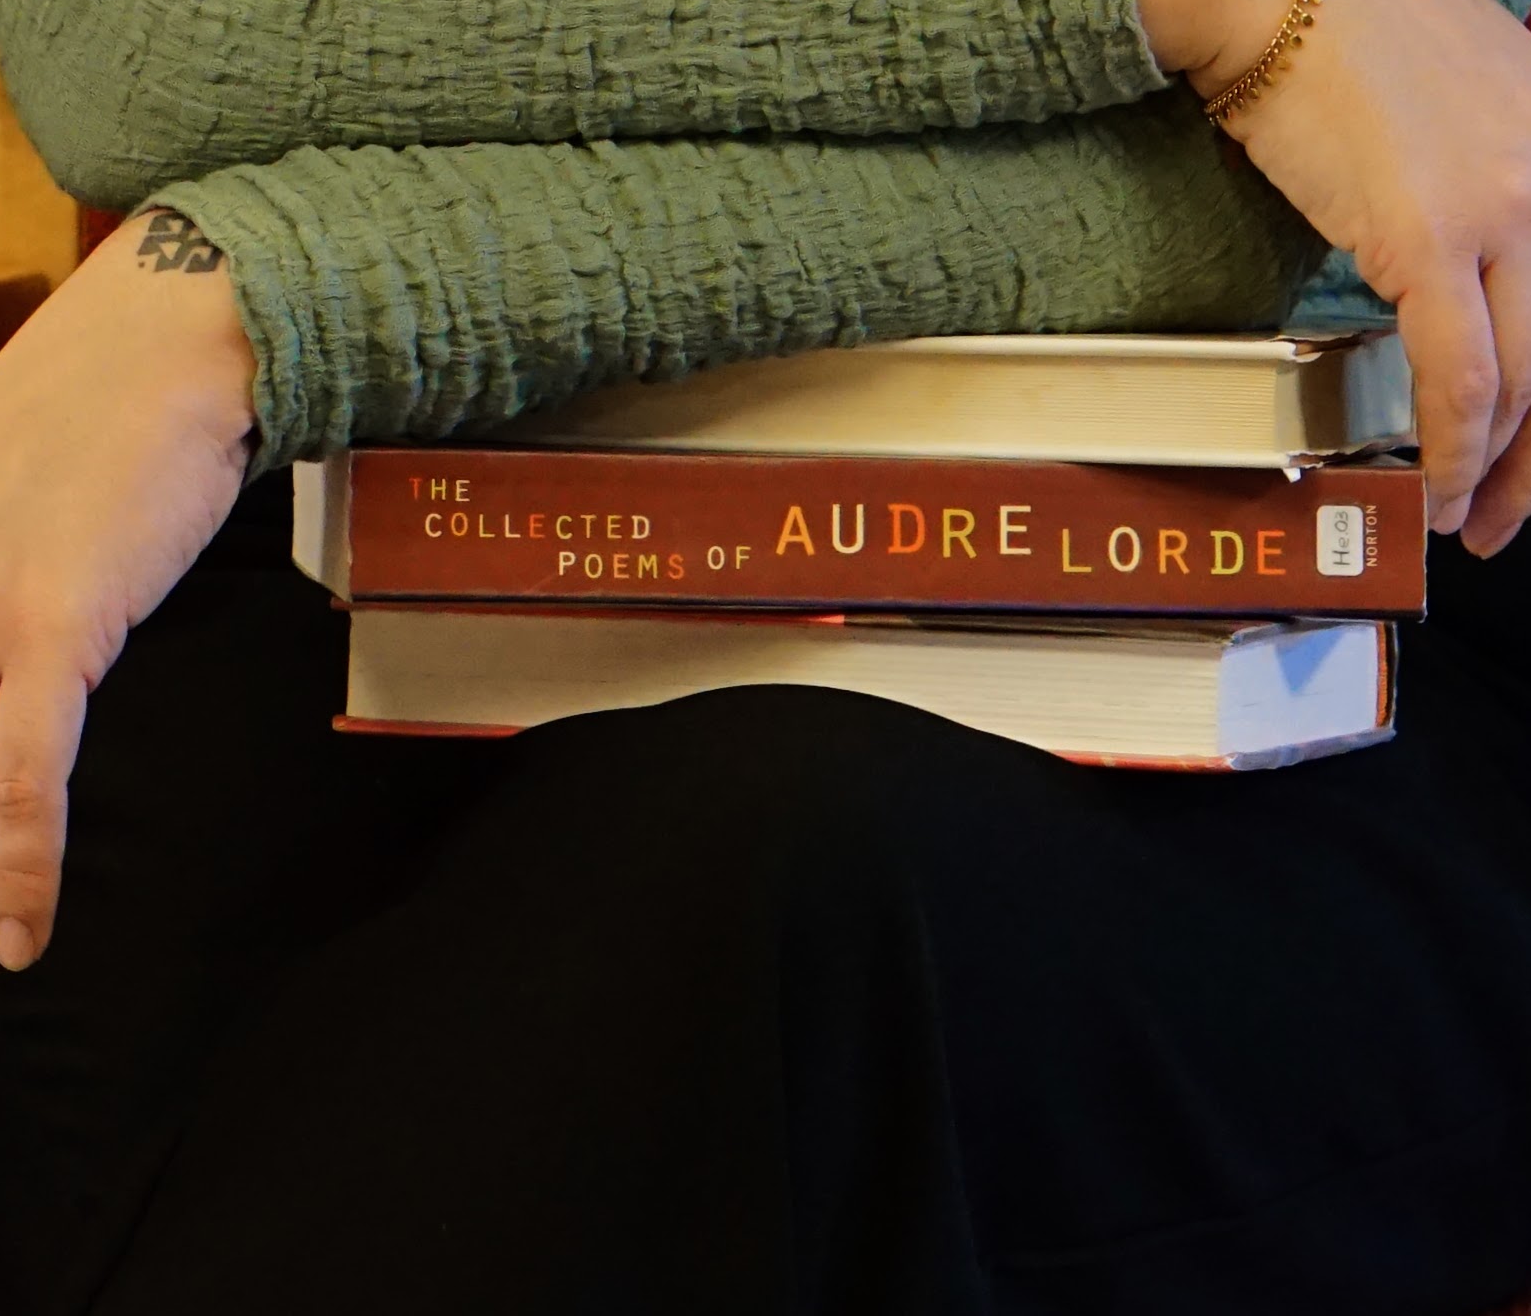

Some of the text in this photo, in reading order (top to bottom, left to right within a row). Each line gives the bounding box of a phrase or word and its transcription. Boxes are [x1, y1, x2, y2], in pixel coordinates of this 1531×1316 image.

[408, 477, 471, 502] THE
[423, 511, 652, 540] COLLECTED
[775, 503, 1032, 560] AUDRE
[1365, 503, 1377, 568] NORTON
[557, 545, 752, 580] POEMS OF
[1061, 526, 1287, 575] LORDE
